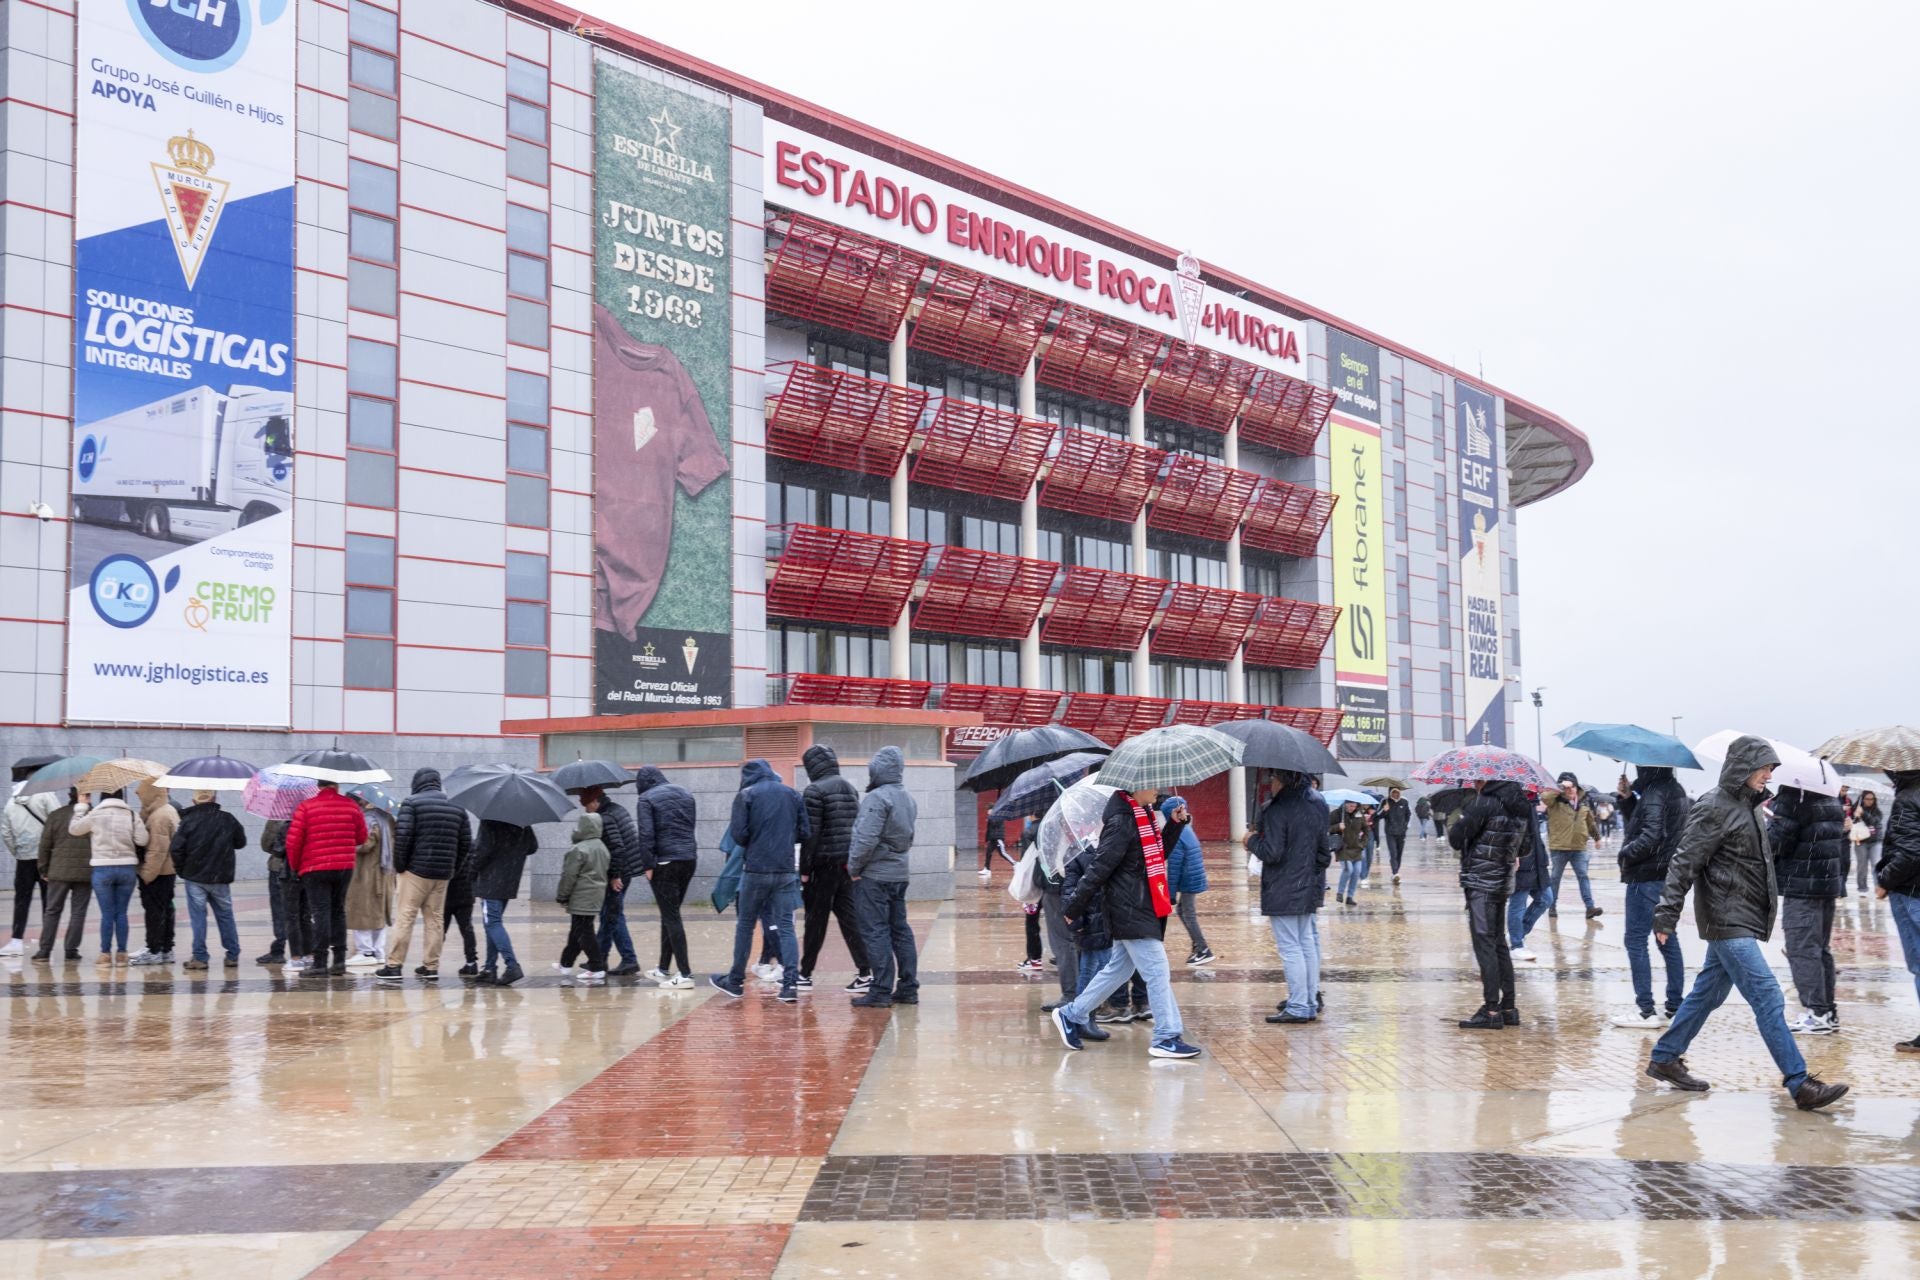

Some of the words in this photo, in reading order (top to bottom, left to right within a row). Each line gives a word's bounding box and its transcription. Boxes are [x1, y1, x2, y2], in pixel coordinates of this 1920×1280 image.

[150, 0, 227, 28] GH
[91, 58, 139, 82] Grupo
[144, 74, 180, 96] José
[184, 85, 233, 112] Guillén
[236, 103, 245, 115] e
[249, 104, 285, 126] Hijos
[91, 80, 157, 112] APOYA
[613, 134, 715, 182] ESTRELLA
[168, 172, 213, 190] MURCIA
[637, 160, 649, 172] DE
[650, 164, 694, 186] LEVANTE
[193, 198, 219, 251] FUTBOL
[603, 200, 725, 258] JUNTOS
[776, 140, 938, 234] ESTADIO
[947, 204, 1092, 290] ENRIQUE
[1098, 259, 1177, 320] ROCA
[1215, 303, 1301, 364] MURCIA
[614, 242, 714, 294] DESDE
[86, 288, 194, 325] SOLUCIONES
[627, 284, 702, 329] 1963
[84, 307, 289, 376] LOGISTICAS
[86, 345, 192, 380] INTEGRALES
[1340, 352, 1369, 376] Siempre
[1346, 375, 1356, 389] en
[1357, 377, 1364, 391] el
[1332, 386, 1354, 402] mejor
[1354, 394, 1377, 411] equipo
[1461, 457, 1493, 490] ERF
[1352, 443, 1369, 591] fibranet
[210, 547, 274, 561] Comprometidos
[244, 559, 274, 571] Contigo
[100, 577, 149, 602] ÖKO
[196, 580, 275, 605] CREMO
[211, 601, 273, 623] FRUIT
[1467, 596, 1488, 613] HASTA
[1489, 600, 1497, 614] EL
[1468, 612, 1497, 636] FINAL
[1468, 634, 1498, 655] VAMOS
[94, 662, 269, 685] www.jghlogistica.es
[1470, 653, 1498, 680] REAL
[607, 690, 622, 701] del
[624, 692, 643, 702] Real
[645, 692, 674, 704] Murcia
[675, 694, 701, 704] desde
[634, 680, 669, 691] Cerveza
[671, 682, 698, 692] Oficial
[964, 726, 1029, 740] FEPEMU
[1357, 716, 1371, 730] 166
[1372, 717, 1386, 731] 177
